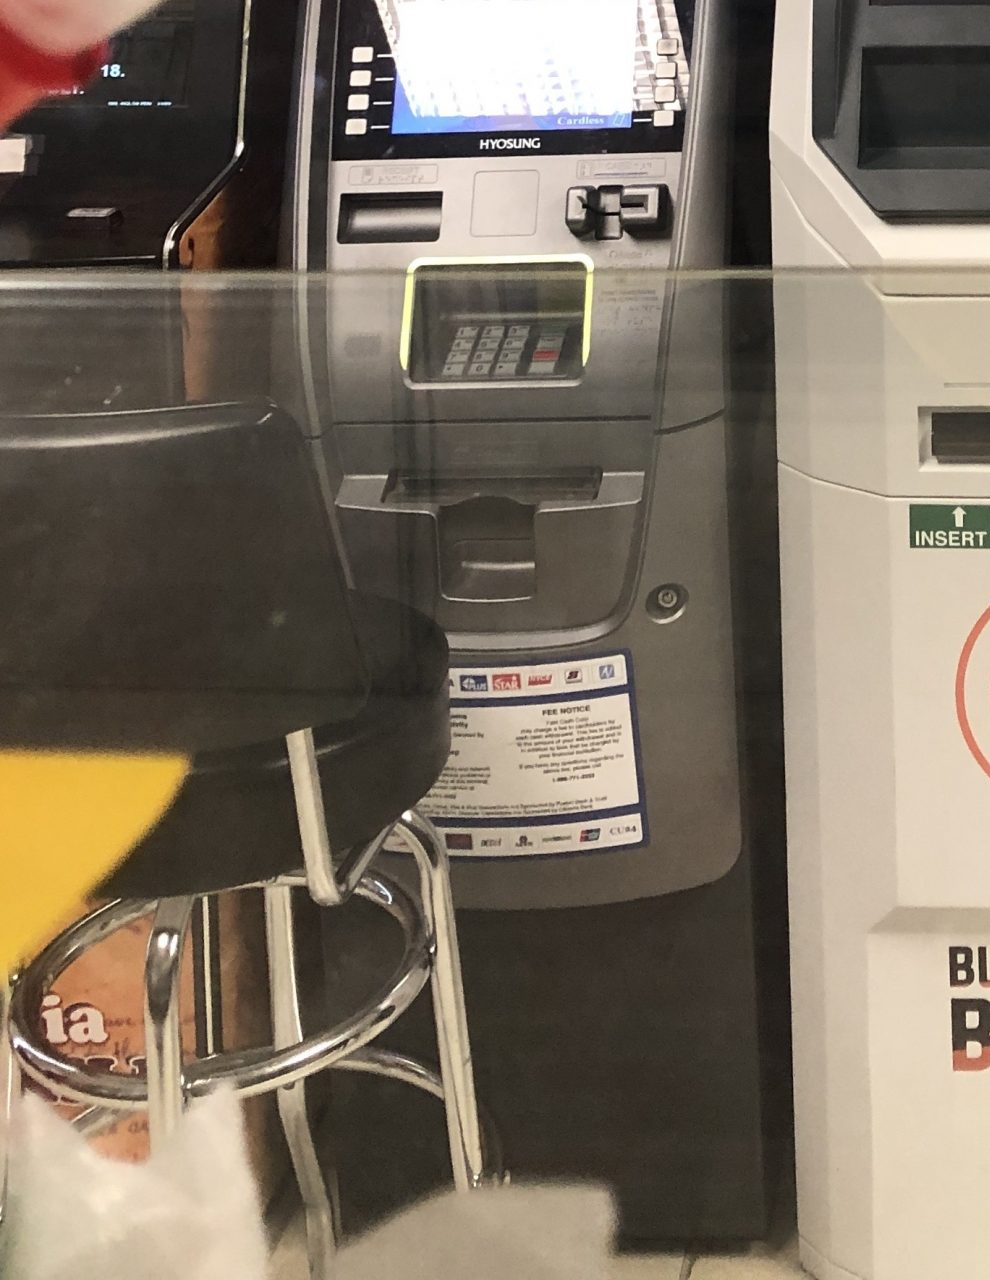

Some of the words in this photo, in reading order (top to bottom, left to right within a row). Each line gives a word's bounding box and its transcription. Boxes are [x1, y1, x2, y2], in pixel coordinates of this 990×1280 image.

[557, 116, 604, 126] Cardless
[479, 137, 541, 150] HYOSUNG
[915, 531, 987, 547] INSERT
[494, 677, 519, 690] STAR
[560, 705, 590, 714] NOTICE
